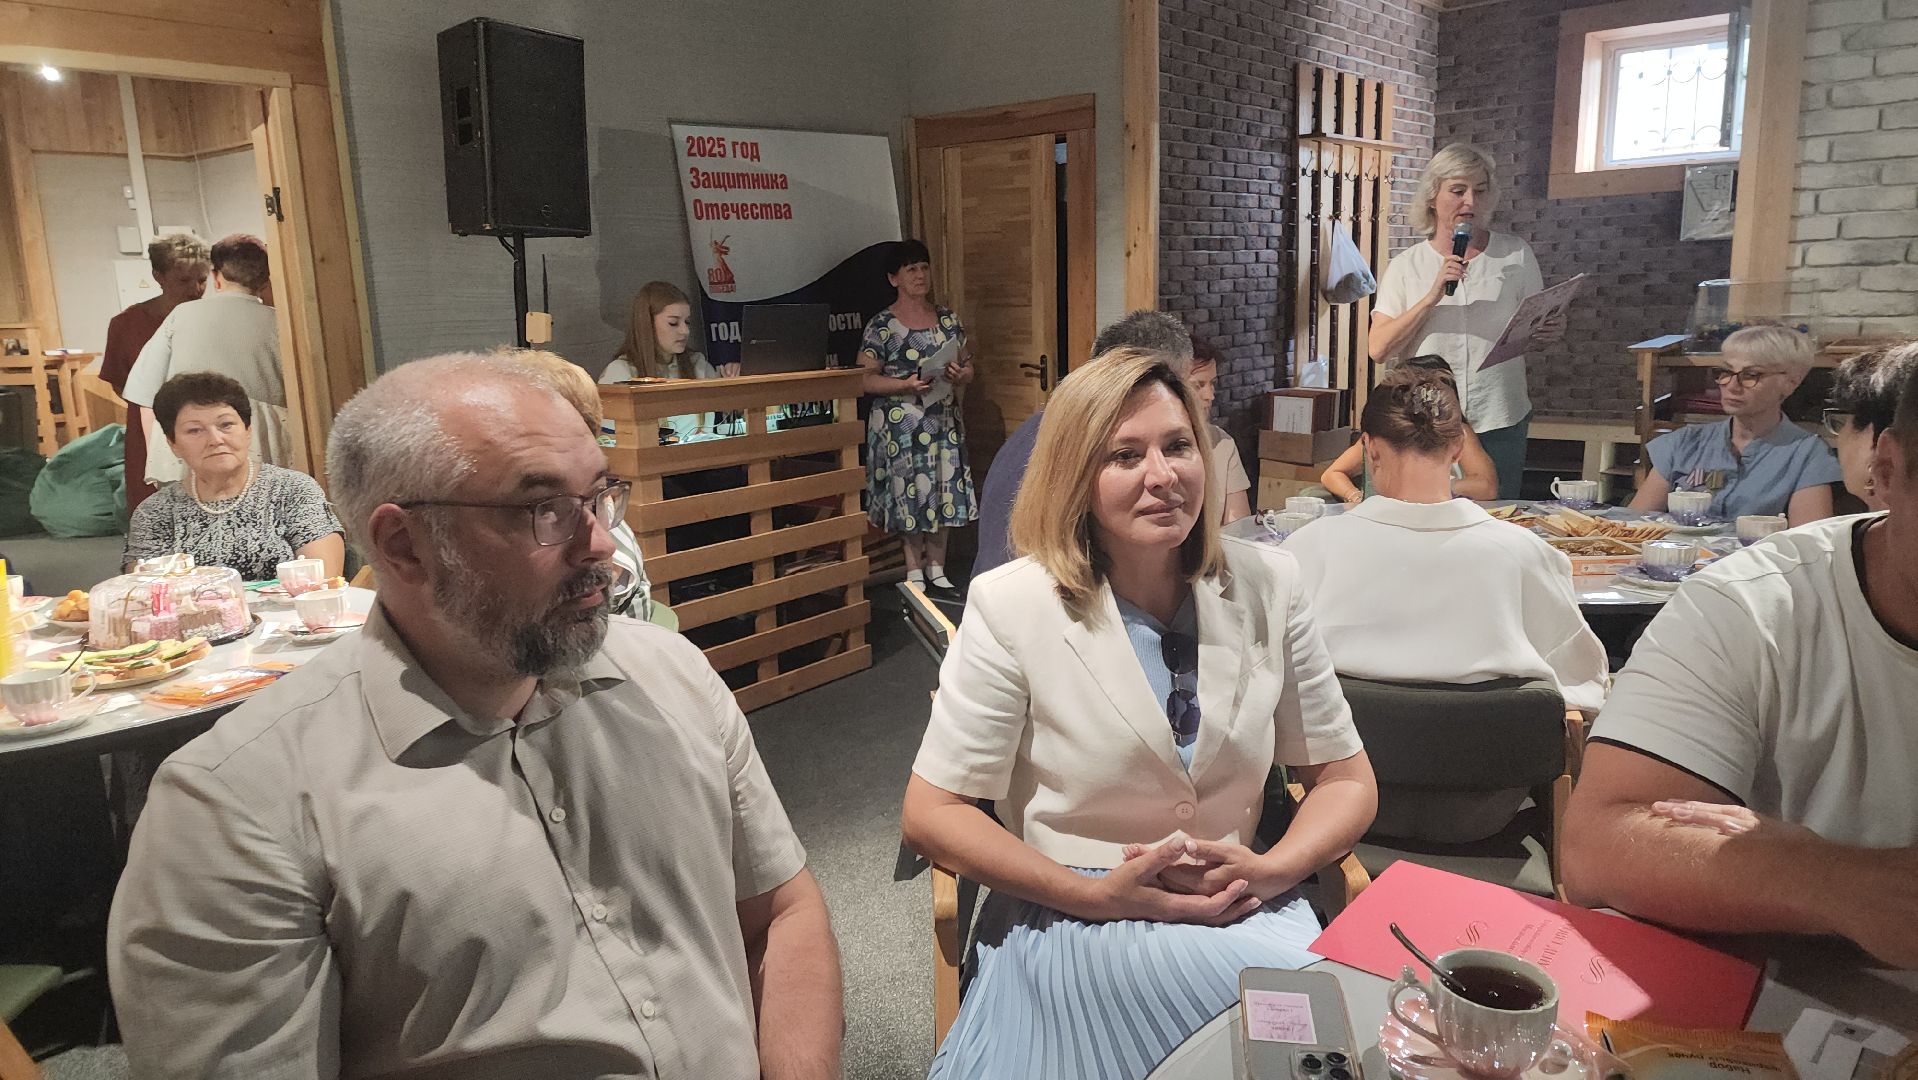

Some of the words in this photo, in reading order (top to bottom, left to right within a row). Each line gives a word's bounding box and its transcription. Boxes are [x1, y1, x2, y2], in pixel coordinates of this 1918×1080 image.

[686, 135, 727, 158] 2025
[731, 140, 761, 161] год
[689, 167, 789, 191] Защитника
[693, 198, 793, 221] Отечества
[710, 321, 742, 343] ГОД
[828, 312, 862, 331] ОСТИ
[1709, 1061, 1751, 1075] Набор
